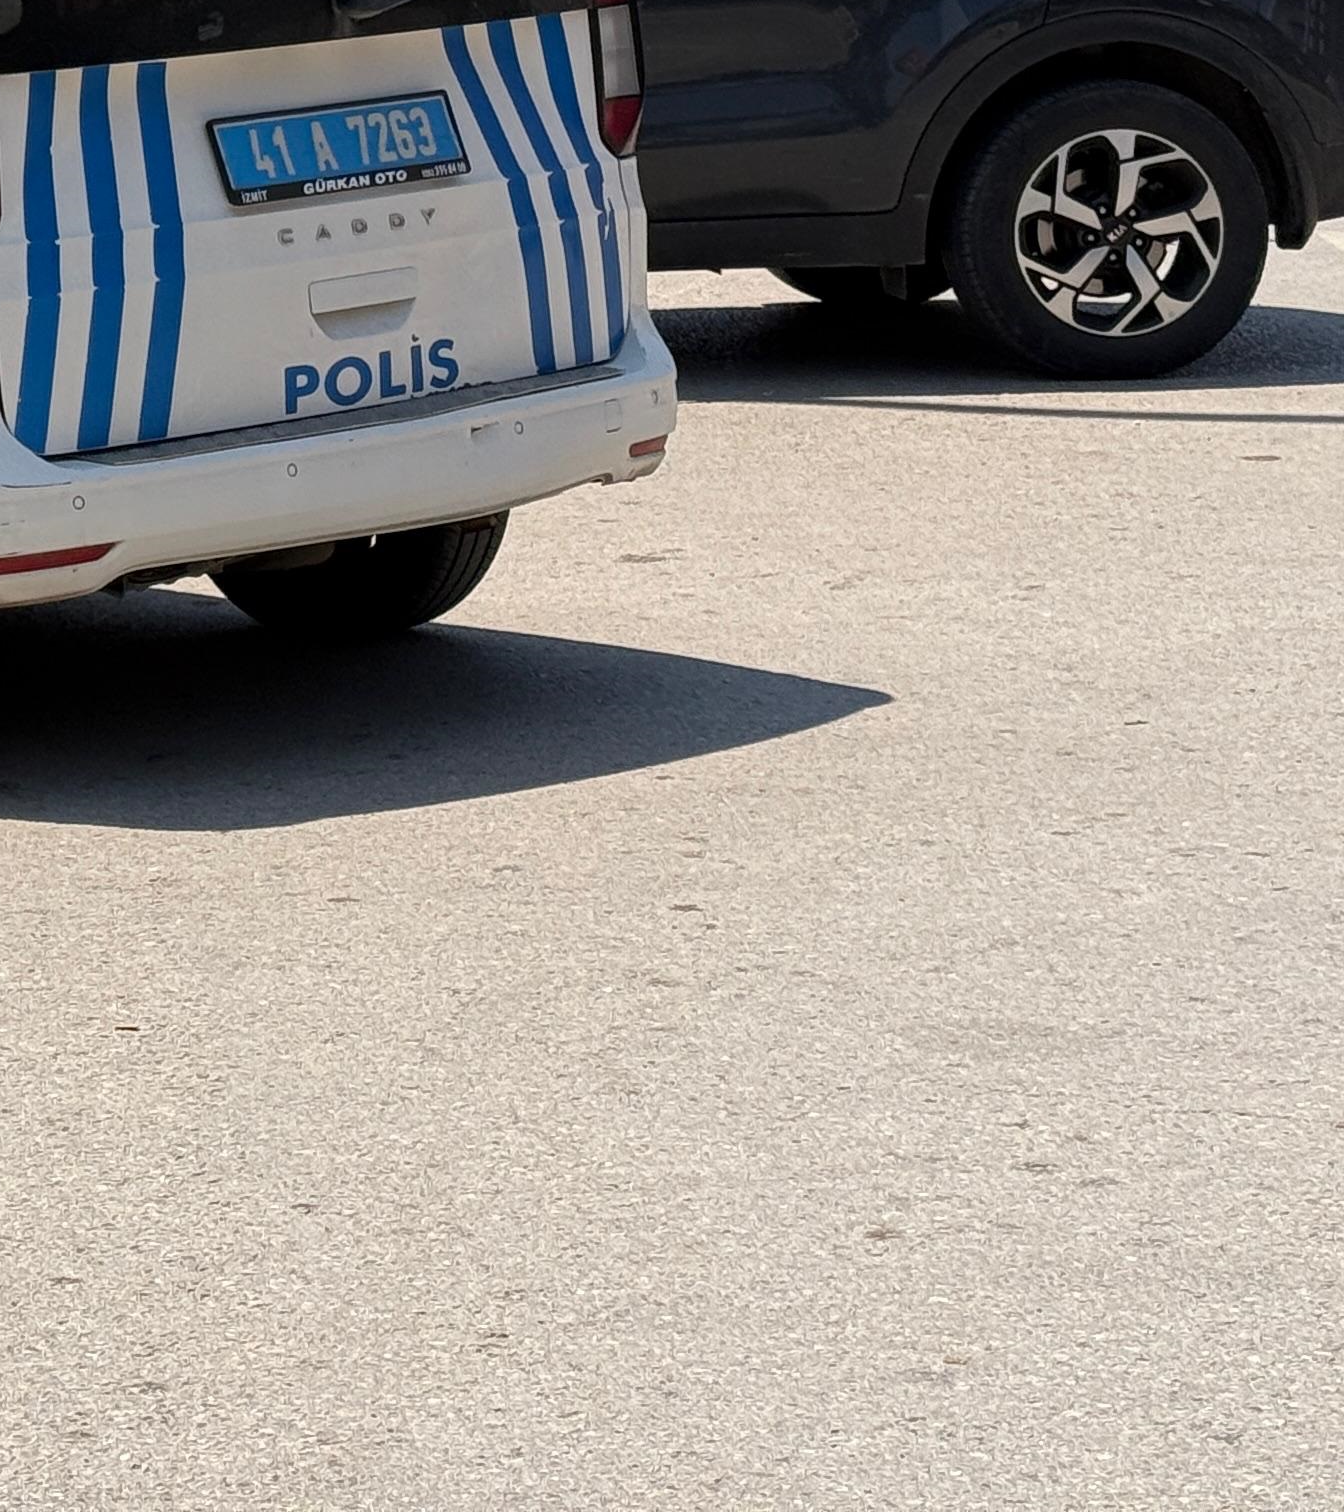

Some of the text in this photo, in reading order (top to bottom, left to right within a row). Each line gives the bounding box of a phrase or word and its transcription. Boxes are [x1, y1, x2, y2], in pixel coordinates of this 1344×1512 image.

[248, 106, 438, 179] 41 A 7263
[303, 174, 372, 196] GÜRKAN
[374, 170, 408, 186] OTO
[276, 208, 436, 247] CADDY
[283, 334, 460, 416] POLİS
